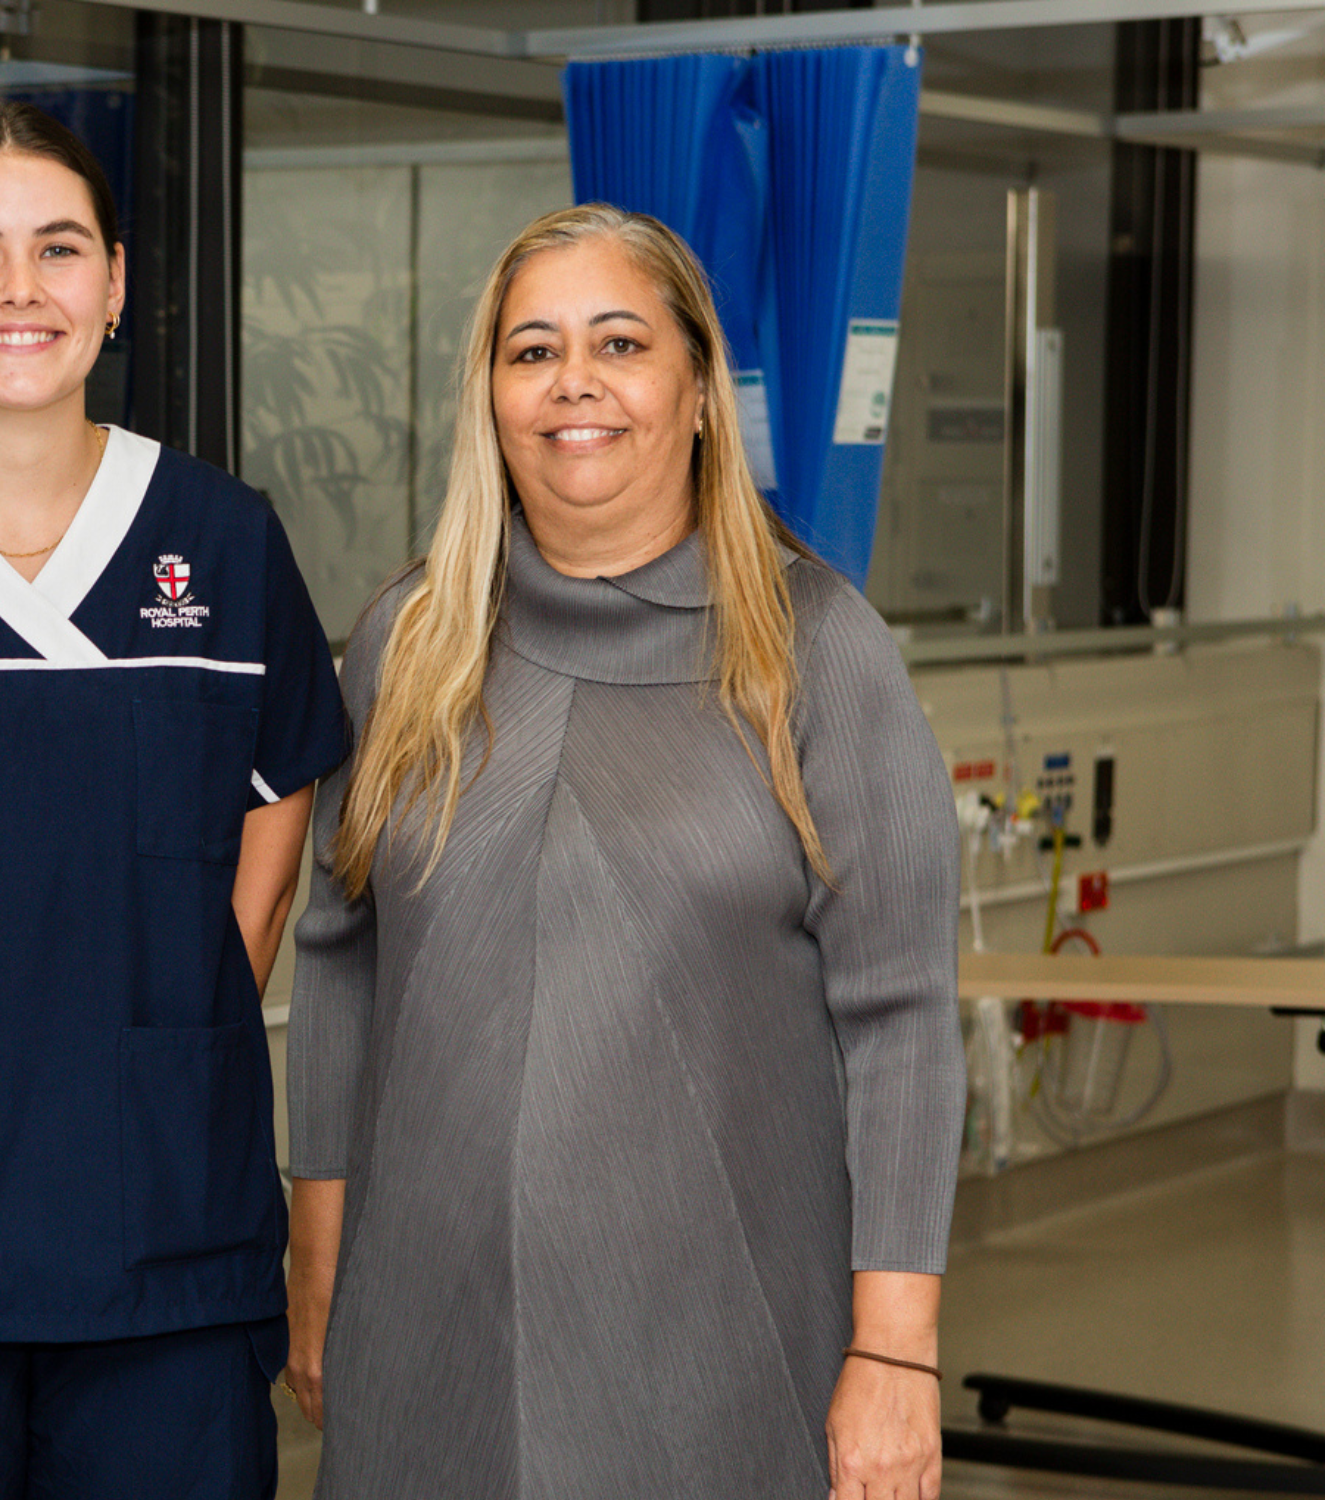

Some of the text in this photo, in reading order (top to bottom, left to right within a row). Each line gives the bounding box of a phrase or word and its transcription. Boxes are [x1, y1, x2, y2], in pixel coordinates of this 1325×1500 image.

[139, 606, 210, 618] ROYAL PERTH
[151, 616, 202, 628] HOSPITAL
